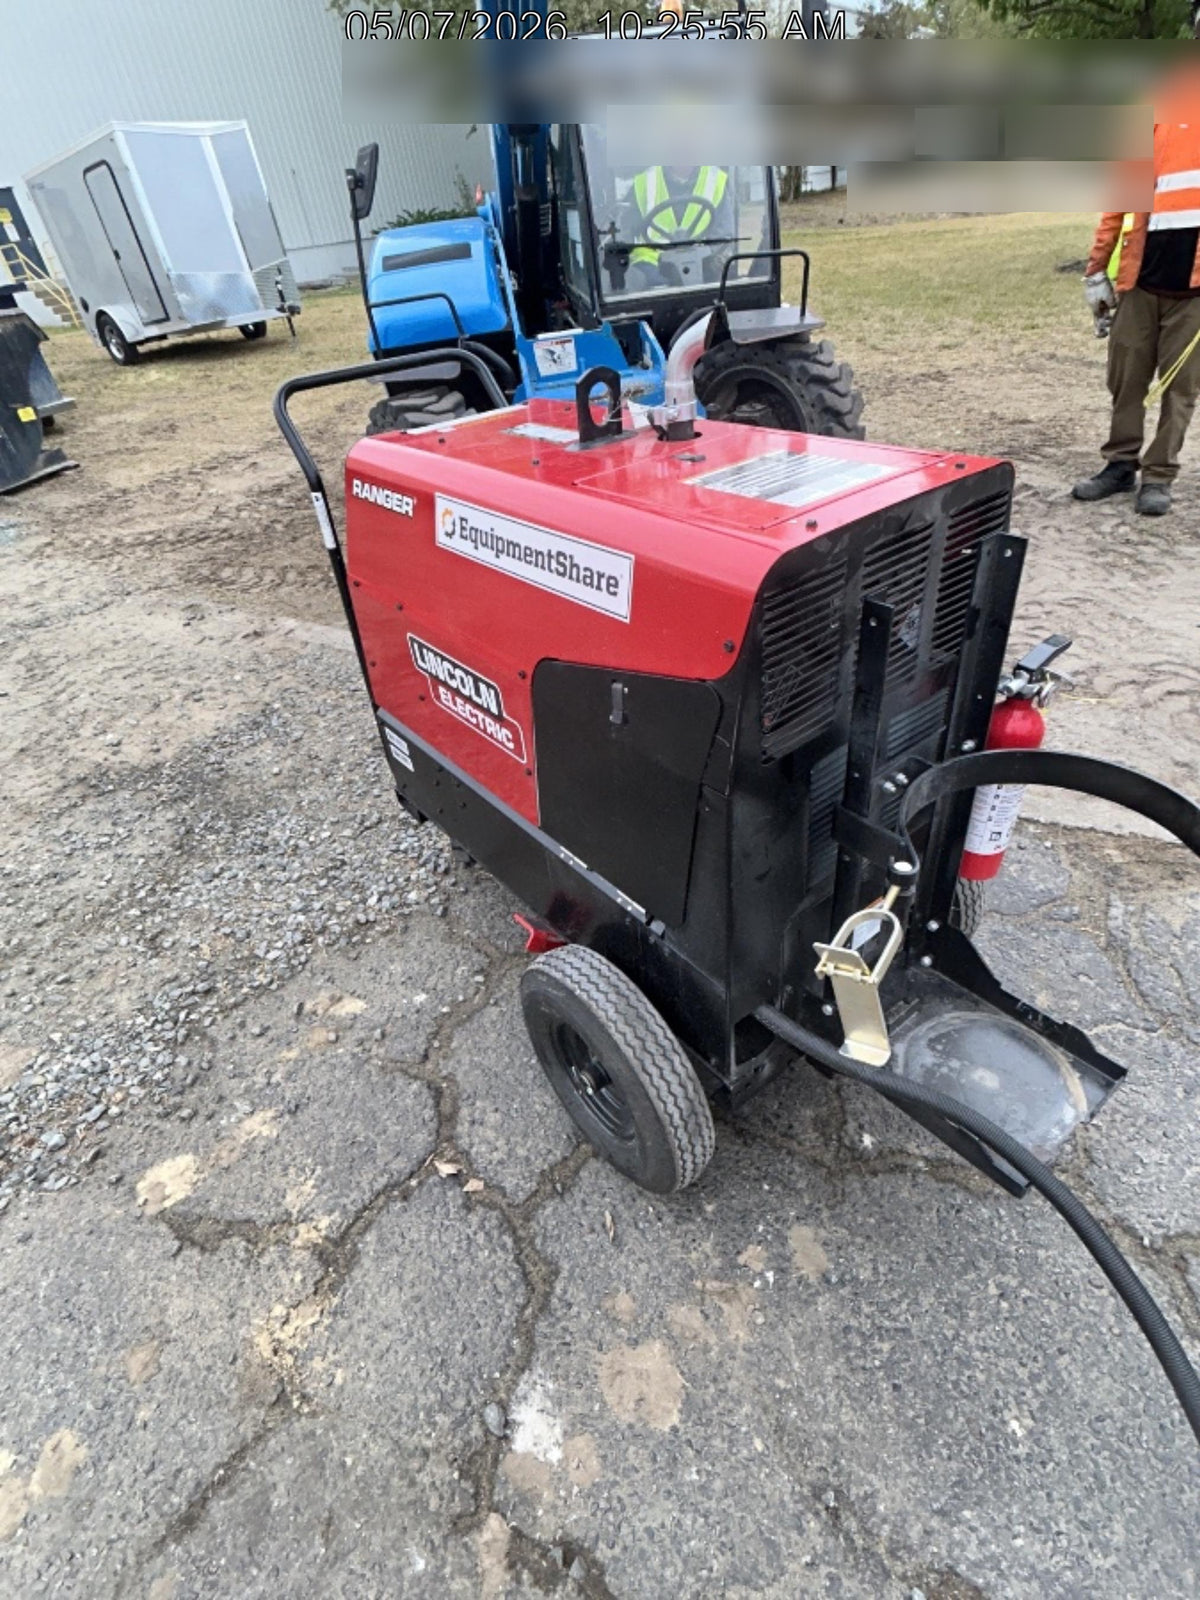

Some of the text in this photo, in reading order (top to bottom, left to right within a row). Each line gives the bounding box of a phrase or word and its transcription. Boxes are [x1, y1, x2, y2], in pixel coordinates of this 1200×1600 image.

[353, 479, 414, 517] RANGER
[458, 516, 620, 597] EquipmentShare
[413, 642, 499, 716] LINCOLN
[438, 685, 515, 750] ELECTRIC
